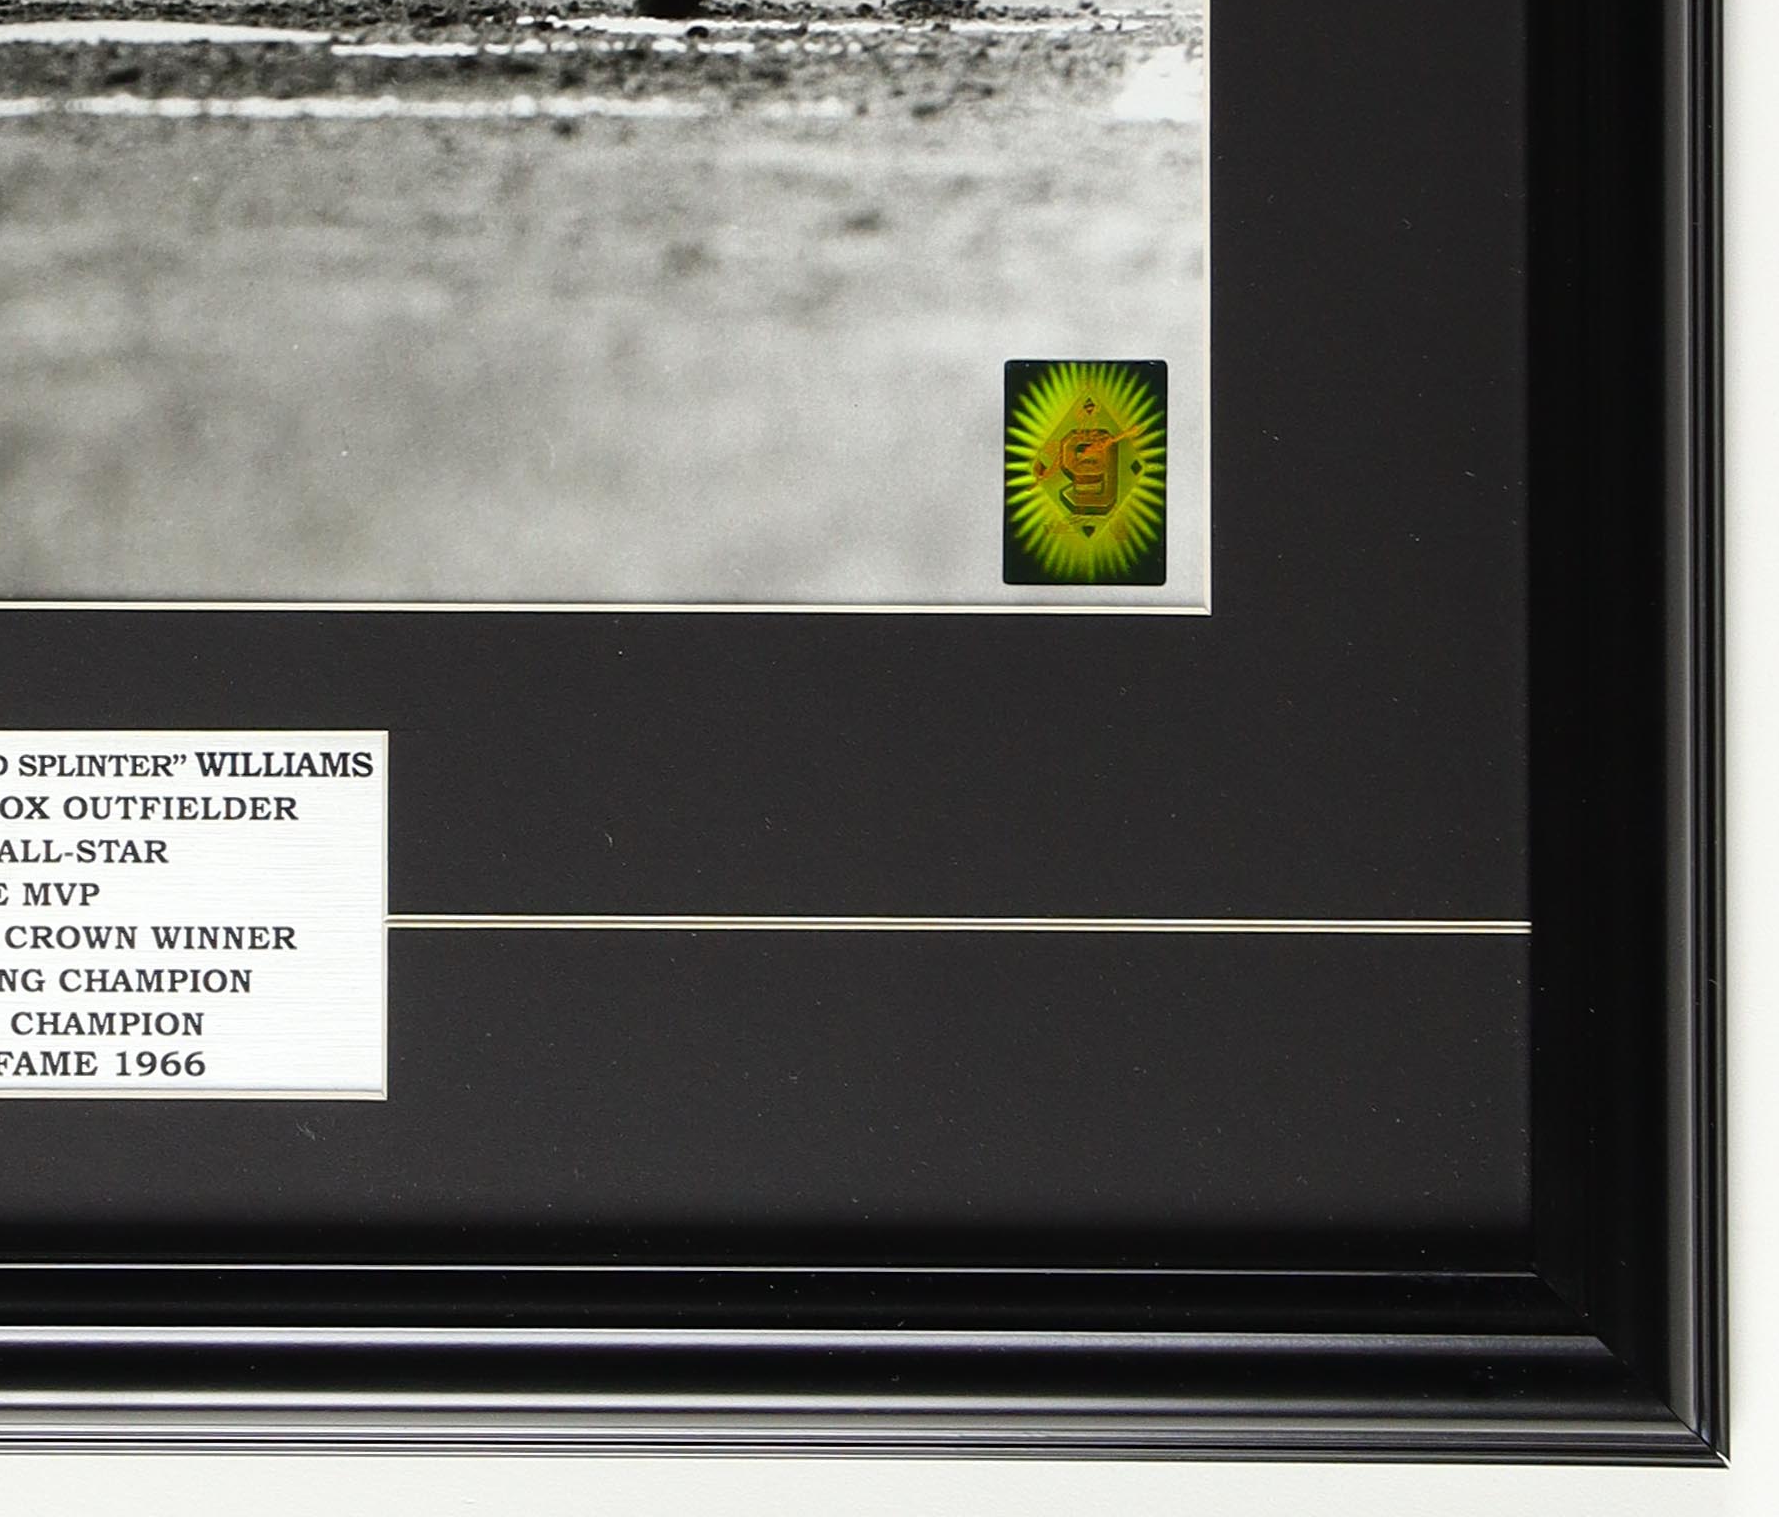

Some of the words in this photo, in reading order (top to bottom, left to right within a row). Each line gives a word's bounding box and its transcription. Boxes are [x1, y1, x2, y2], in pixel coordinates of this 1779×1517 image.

[195, 751, 374, 778] WILLIAMS
[63, 795, 299, 821] OUTFIELDER
[23, 882, 100, 906] MVP
[5, 925, 138, 950] CROWN
[152, 926, 297, 950] WINNER
[59, 968, 252, 993] CHAMPION
[11, 1011, 204, 1036] CHAMPION
[116, 1051, 206, 1077] 1966
